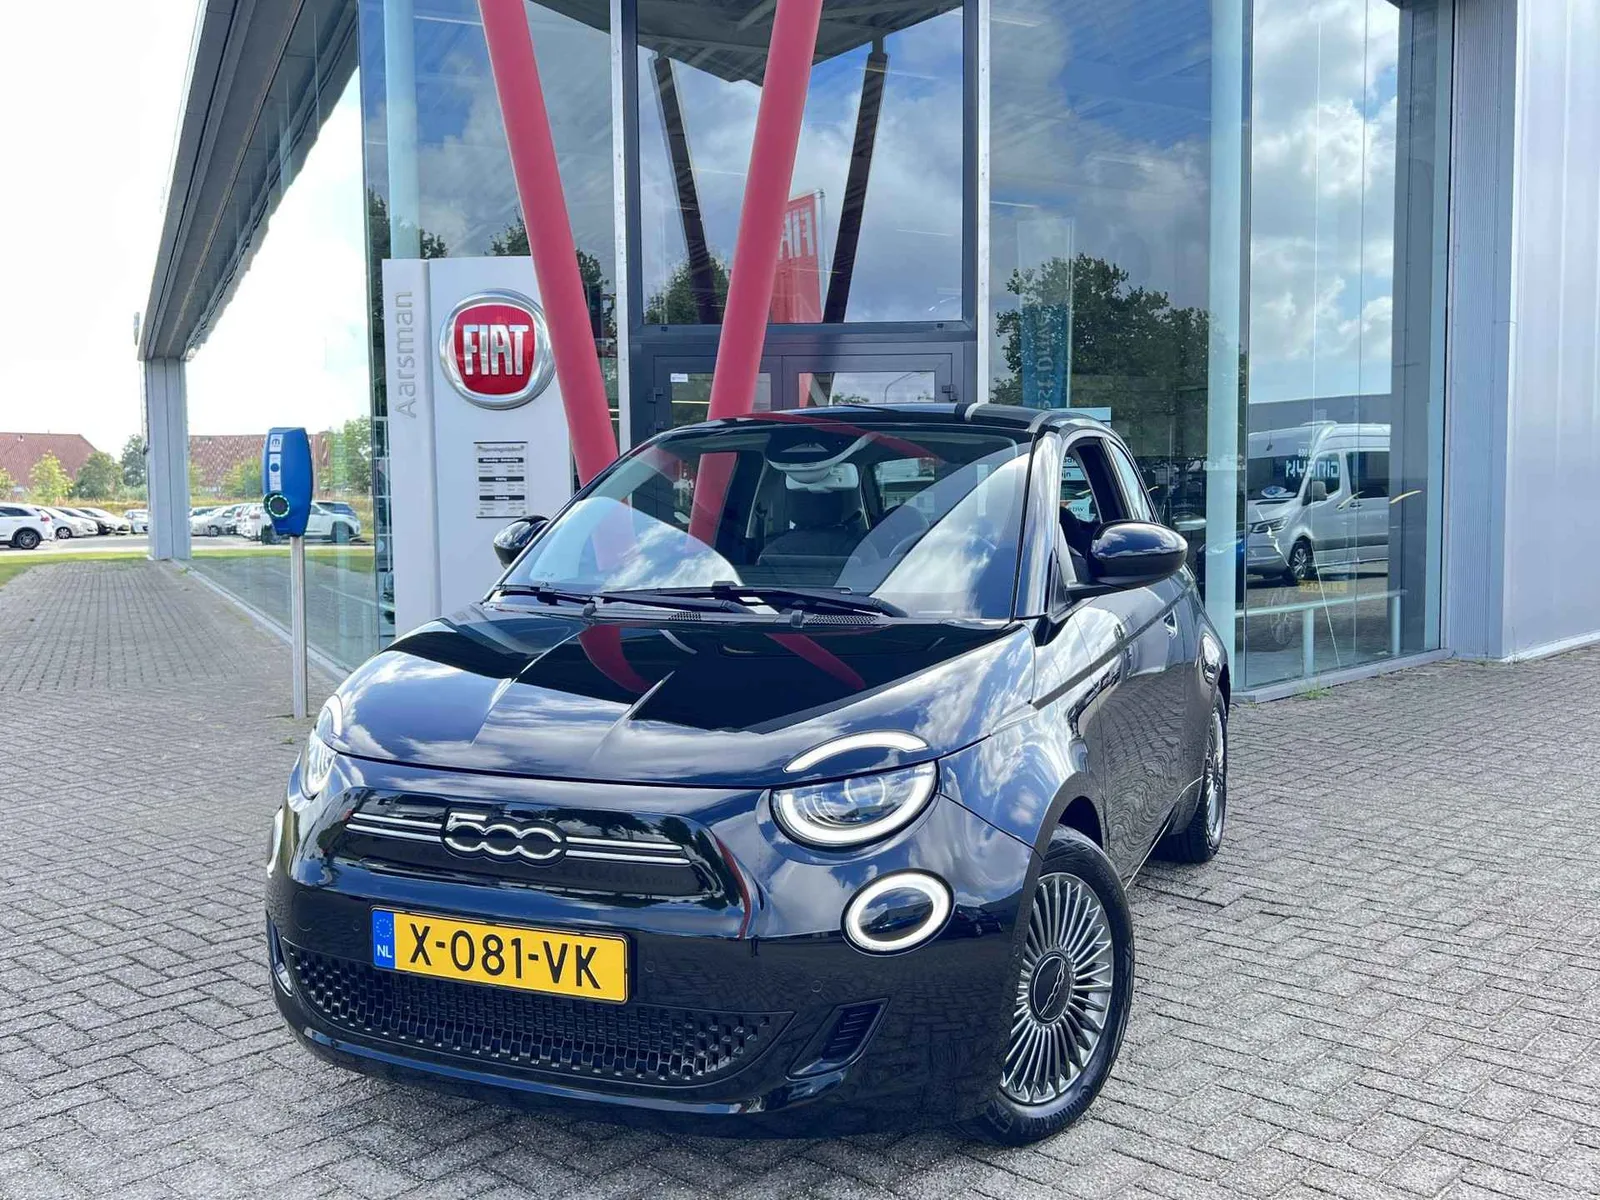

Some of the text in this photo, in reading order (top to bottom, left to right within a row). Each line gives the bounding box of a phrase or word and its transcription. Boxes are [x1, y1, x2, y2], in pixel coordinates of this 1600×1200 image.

[394, 291, 417, 420] Aarsman
[462, 324, 529, 376] FIAT
[1285, 459, 1340, 478] HYRID
[443, 811, 562, 860] 500
[376, 943, 393, 960] NL
[408, 922, 602, 990] X-081-VK
